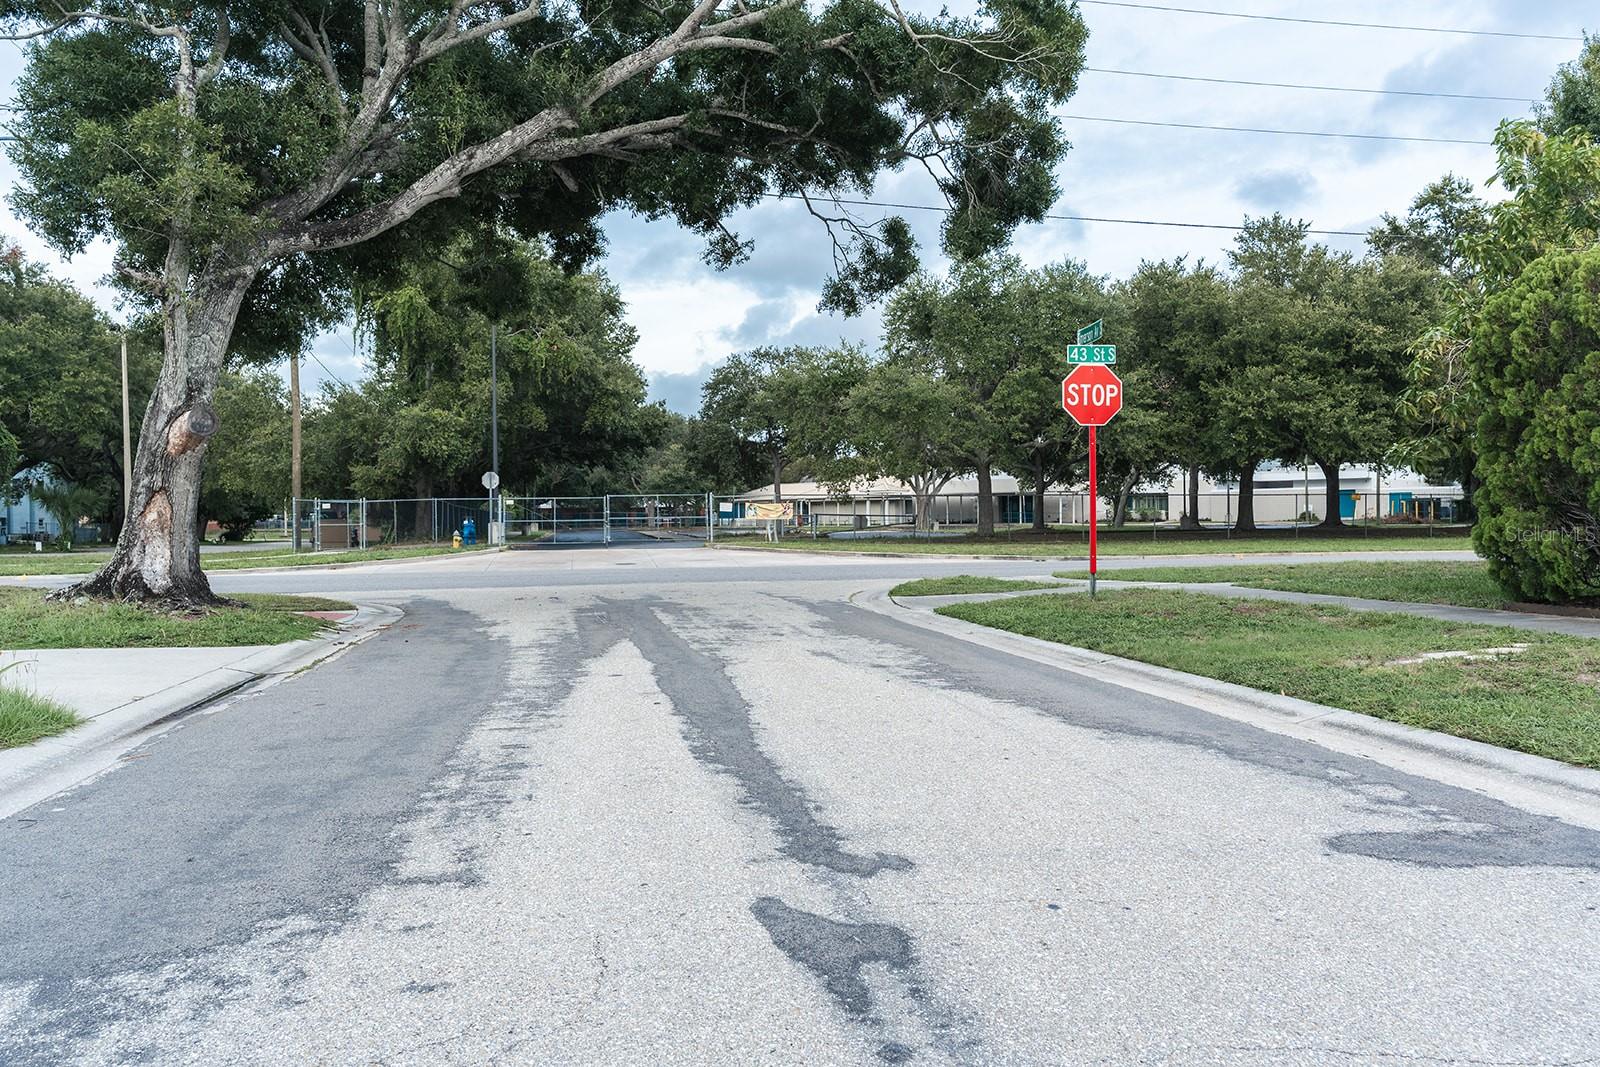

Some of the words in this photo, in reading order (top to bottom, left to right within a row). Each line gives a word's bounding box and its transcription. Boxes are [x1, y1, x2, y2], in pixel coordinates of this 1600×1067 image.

[1070, 347, 1087, 361] 43
[1093, 347, 1105, 361] St
[1108, 347, 1115, 361] S
[1067, 383, 1118, 406] STOP
